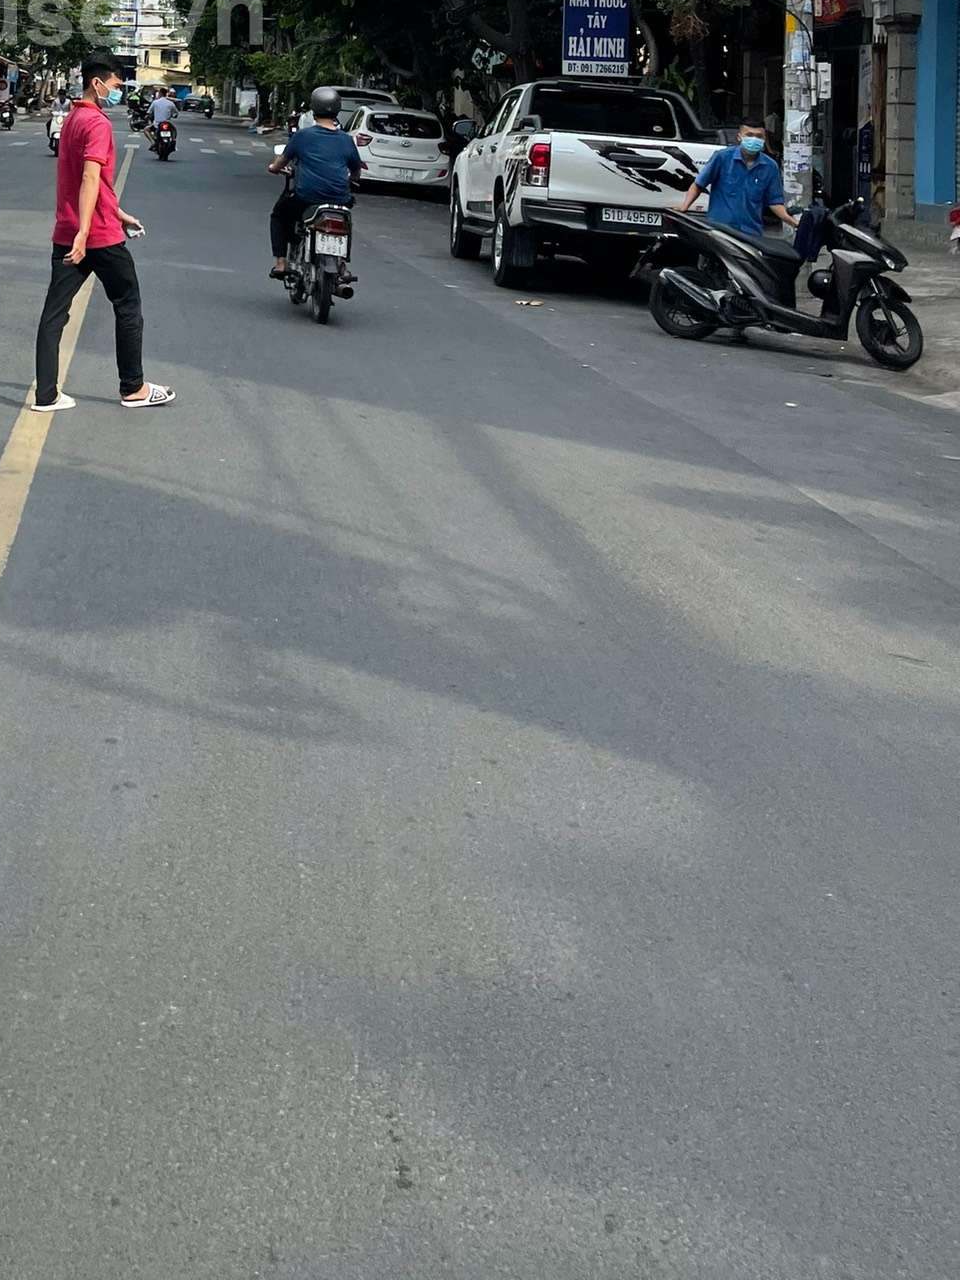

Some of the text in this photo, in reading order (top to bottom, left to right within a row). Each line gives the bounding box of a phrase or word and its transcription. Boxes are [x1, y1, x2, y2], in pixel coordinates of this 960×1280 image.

[587, 12, 607, 29] TÂY
[568, 28, 625, 58] HẢI MINH
[580, 62, 593, 73] 091
